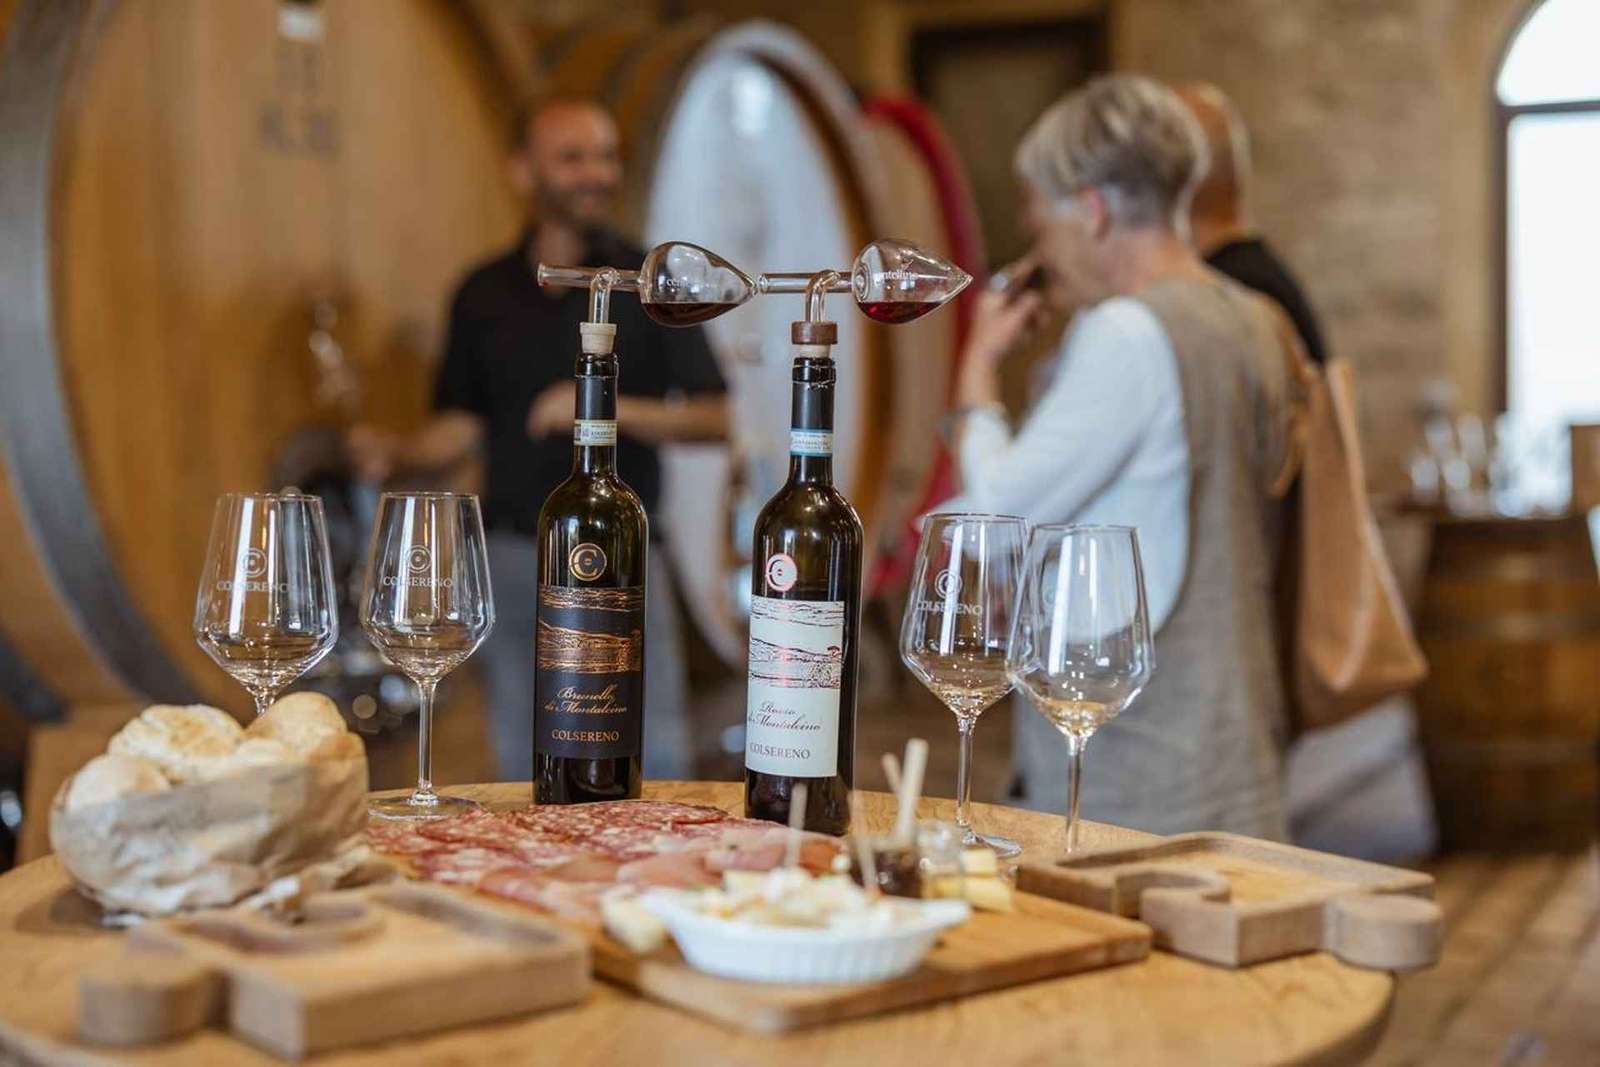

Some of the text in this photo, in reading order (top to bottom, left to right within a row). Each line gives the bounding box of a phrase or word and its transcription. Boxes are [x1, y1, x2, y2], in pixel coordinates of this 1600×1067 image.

[216, 581, 288, 592] COEREO
[382, 576, 453, 588] COEREO
[916, 601, 982, 615] COLSEENO
[556, 684, 618, 702] Brunello
[560, 701, 627, 714] Montalcino
[551, 729, 620, 742] COLSERENO
[749, 743, 811, 760] COLSERENO
